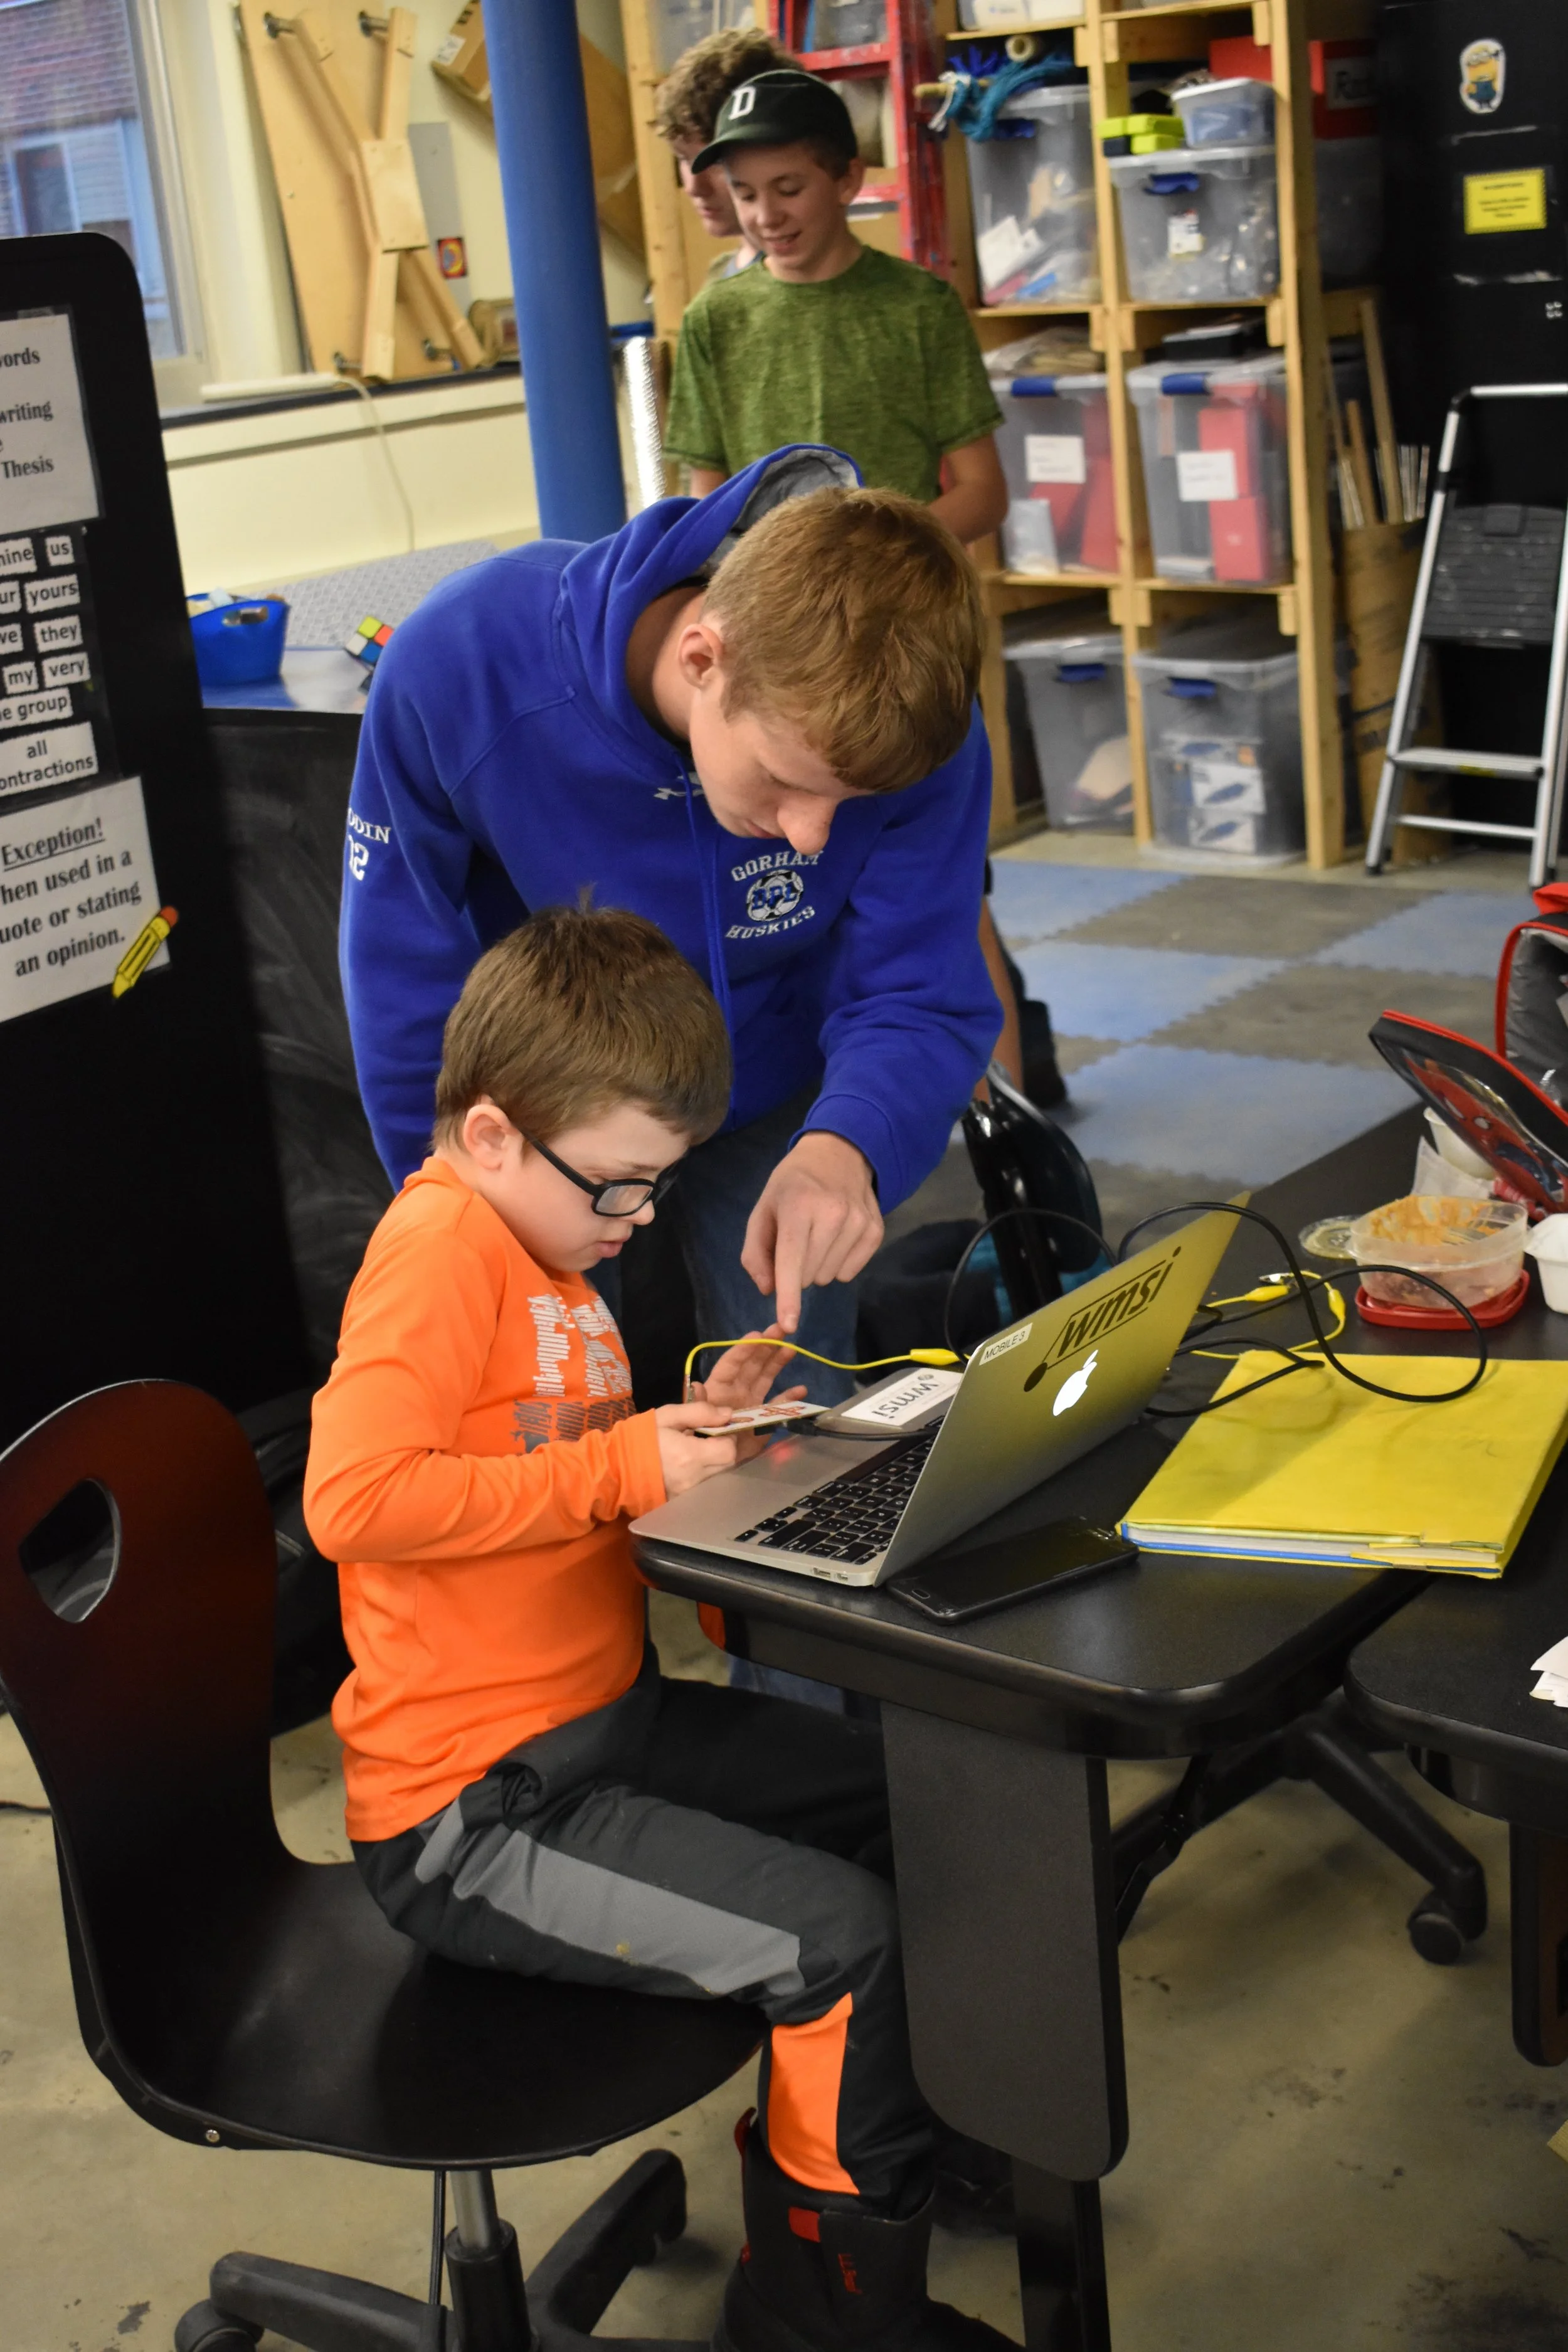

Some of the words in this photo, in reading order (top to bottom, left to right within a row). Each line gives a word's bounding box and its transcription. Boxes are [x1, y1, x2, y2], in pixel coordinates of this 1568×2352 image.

[729, 87, 756, 120] D
[0, 347, 41, 368] ords
[1, 456, 55, 479] Thesis
[50, 542, 70, 556] us
[29, 582, 78, 607] yours
[41, 625, 77, 644] they
[8, 669, 33, 686] my
[48, 659, 85, 677] very
[18, 696, 68, 721] group
[27, 739, 48, 758] all
[1, 817, 104, 868] Exception!
[45, 858, 92, 892] used
[96, 854, 116, 876] in
[120, 850, 133, 867] a
[731, 850, 824, 881] GORHAM
[49, 907, 70, 928] or
[77, 881, 142, 919] stating
[724, 906, 815, 939] HUSKIES
[16, 955, 40, 977] an
[47, 928, 126, 967] opinion.
[1057, 1246, 1182, 1359] wmsi
[984, 1334, 1019, 1360] MOBILE
[1019, 1330, 1026, 1342] 3
